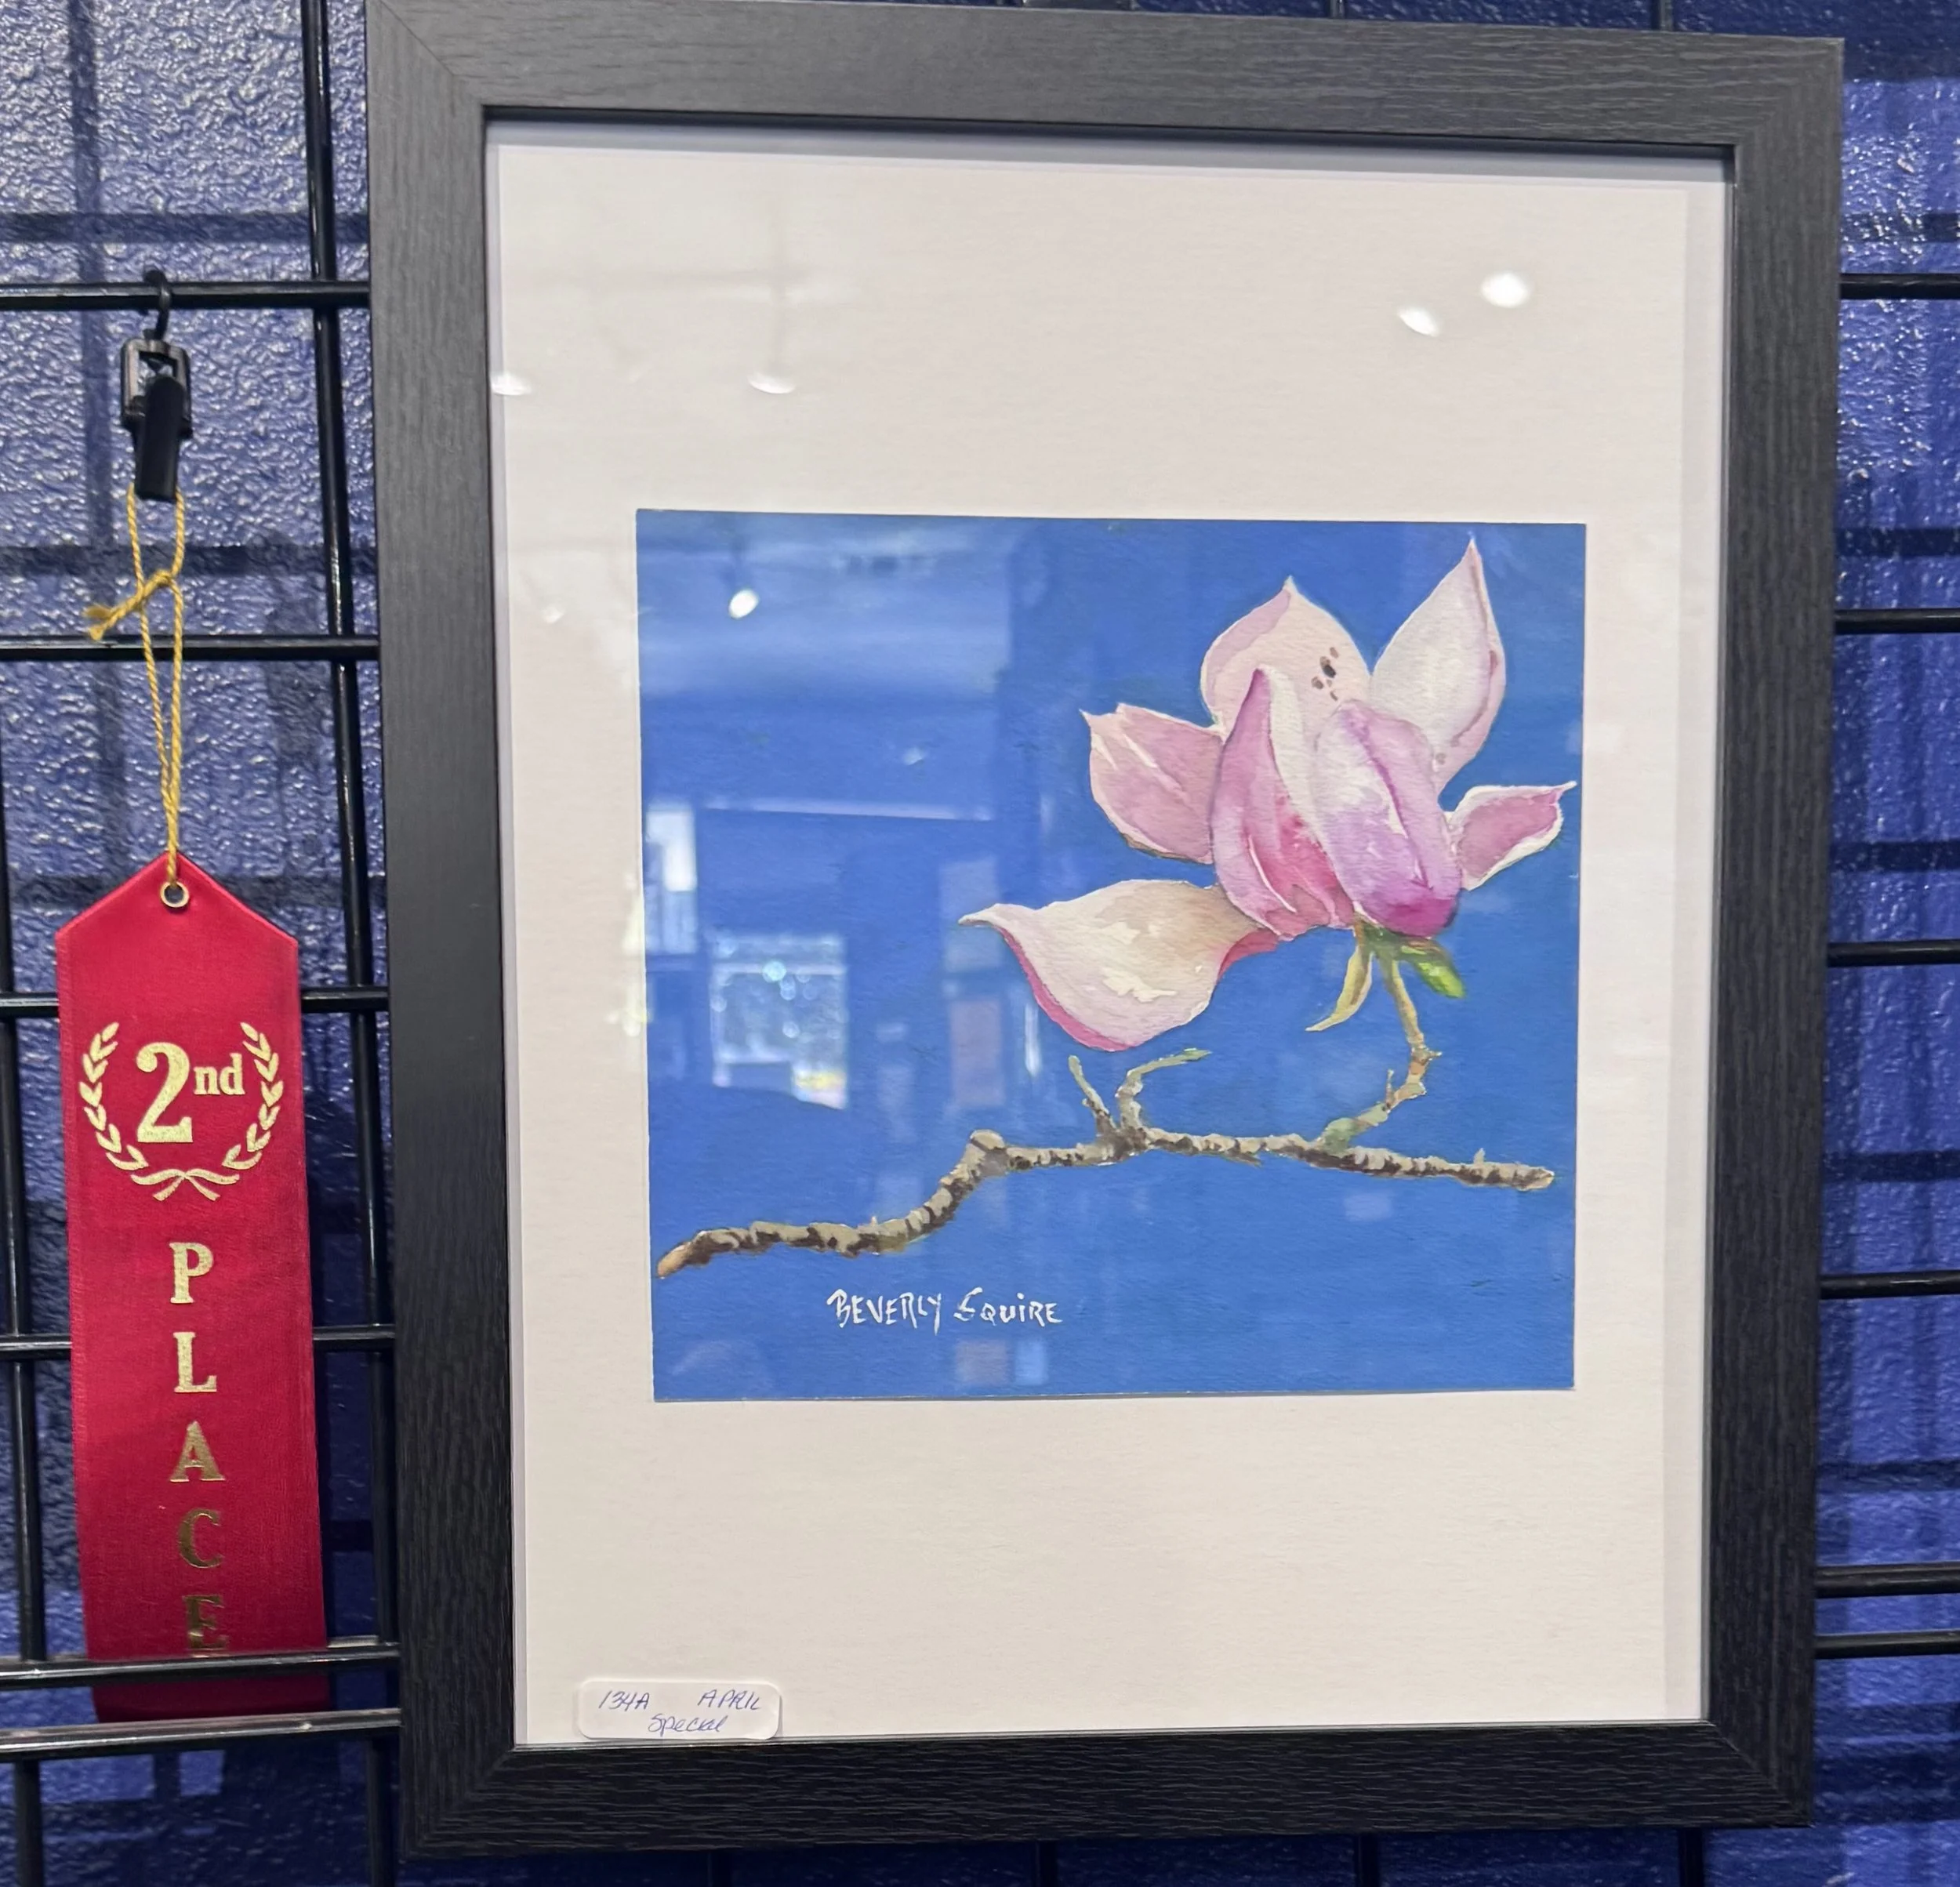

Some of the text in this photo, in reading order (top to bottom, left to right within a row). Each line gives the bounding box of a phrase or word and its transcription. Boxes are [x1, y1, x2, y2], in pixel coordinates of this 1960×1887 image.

[135, 1041, 245, 1143] 2nd
[826, 1288, 942, 1336] BEVERLY
[168, 1241, 230, 1651] PLACE
[697, 1689, 760, 1711] APRIL
